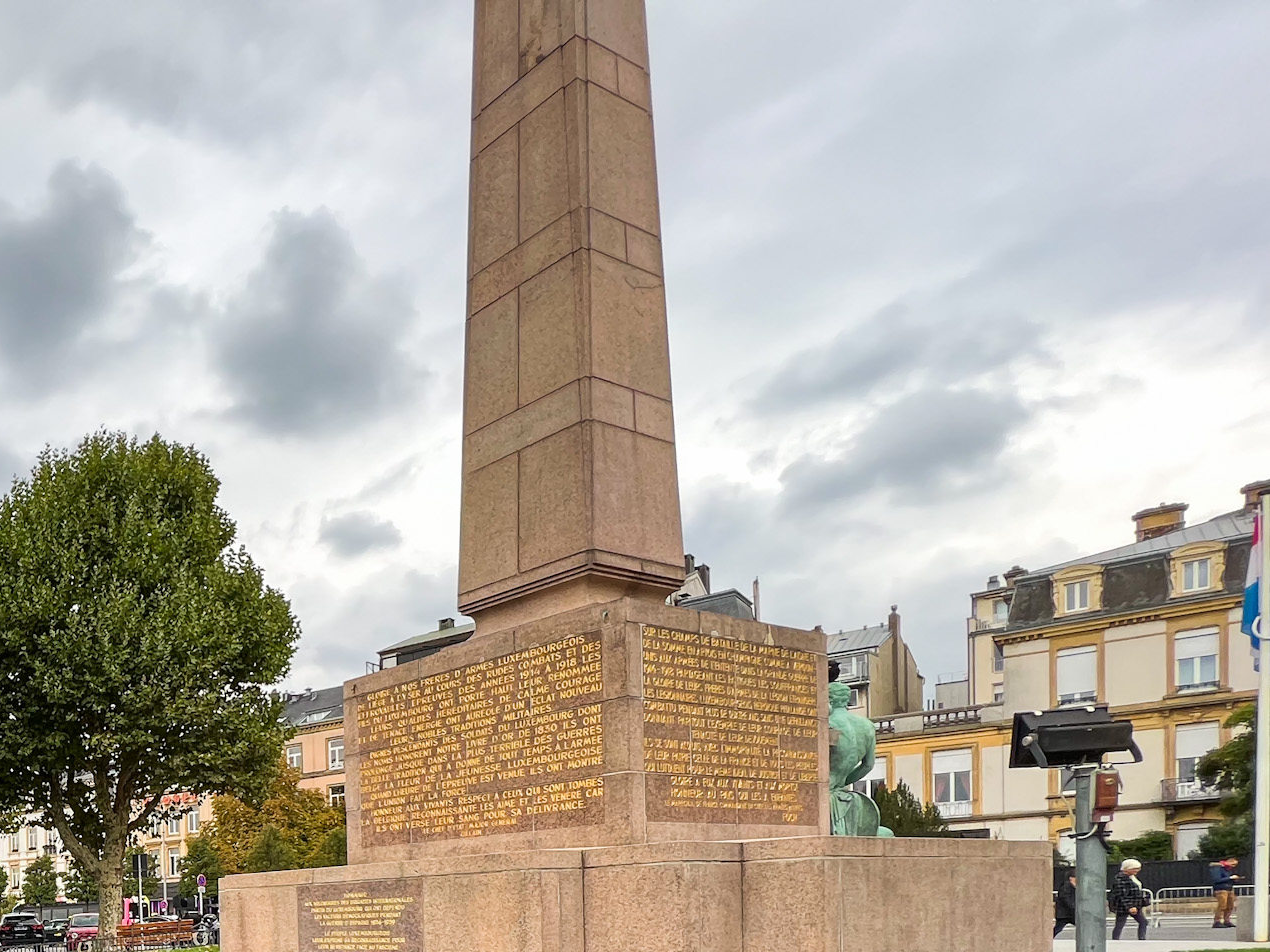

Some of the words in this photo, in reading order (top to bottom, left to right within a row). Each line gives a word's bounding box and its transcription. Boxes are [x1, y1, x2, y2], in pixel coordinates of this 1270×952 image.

[436, 677, 461, 691] COURS
[466, 672, 481, 683] DES
[486, 663, 514, 678] RUDES
[518, 651, 561, 670] COMBATS
[566, 646, 576, 657] ET
[581, 640, 601, 653] DES
[498, 634, 584, 666] LUXEMBOURGEOIS
[458, 683, 475, 695] DES
[519, 667, 540, 679] 1914
[556, 658, 576, 670] 1918
[582, 651, 601, 664] LES
[499, 693, 511, 703] DE
[517, 684, 549, 699] CALME
[555, 672, 601, 690] COURAGE
[439, 698, 453, 708] ONT
[491, 683, 513, 695] HAUT
[518, 676, 542, 689] LEUR
[445, 714, 461, 725] ONT
[560, 682, 602, 699] NOUVEAU
[442, 734, 456, 744] DES
[498, 723, 510, 732] DU
[514, 709, 573, 729] LUXEMBOURG
[577, 703, 602, 716] DONT
[450, 716, 496, 732] TRADITIONS
[518, 728, 530, 738] DE
[563, 719, 576, 729] ILS
[582, 713, 602, 725] ONT
[427, 754, 447, 764] DANS
[451, 751, 461, 760] LA
[467, 747, 485, 757] PLUS
[489, 738, 530, 753] TERRIBLE
[534, 734, 551, 745] DES
[556, 724, 602, 741] GUERRES
[484, 754, 494, 763] DE
[499, 750, 517, 761] TOUT
[523, 744, 551, 756] TEMPS
[385, 781, 393, 789] LA
[425, 774, 436, 782] DE
[440, 771, 451, 780] LA
[456, 762, 501, 777] JEUNESSE
[507, 745, 602, 768] LUXEMBOURGEOISE
[422, 783, 431, 792] DE
[480, 773, 494, 782] EST
[497, 768, 525, 780] VENUE
[529, 765, 543, 775] ILS
[547, 762, 563, 772] ONT
[409, 793, 424, 802] FAIT
[427, 791, 437, 799] LA
[458, 793, 490, 805] RESPECT
[502, 788, 522, 798] CEUX
[526, 785, 540, 795] QUI
[543, 782, 564, 793] SONT
[480, 802, 493, 811] LES
[519, 797, 527, 806] ET
[533, 794, 547, 804] LES
[585, 787, 603, 797] CAR
[389, 822, 402, 831] ONT
[434, 816, 454, 825] LEUR
[459, 813, 479, 822] SANG
[483, 809, 505, 819] POUR
[511, 807, 522, 816] SA
